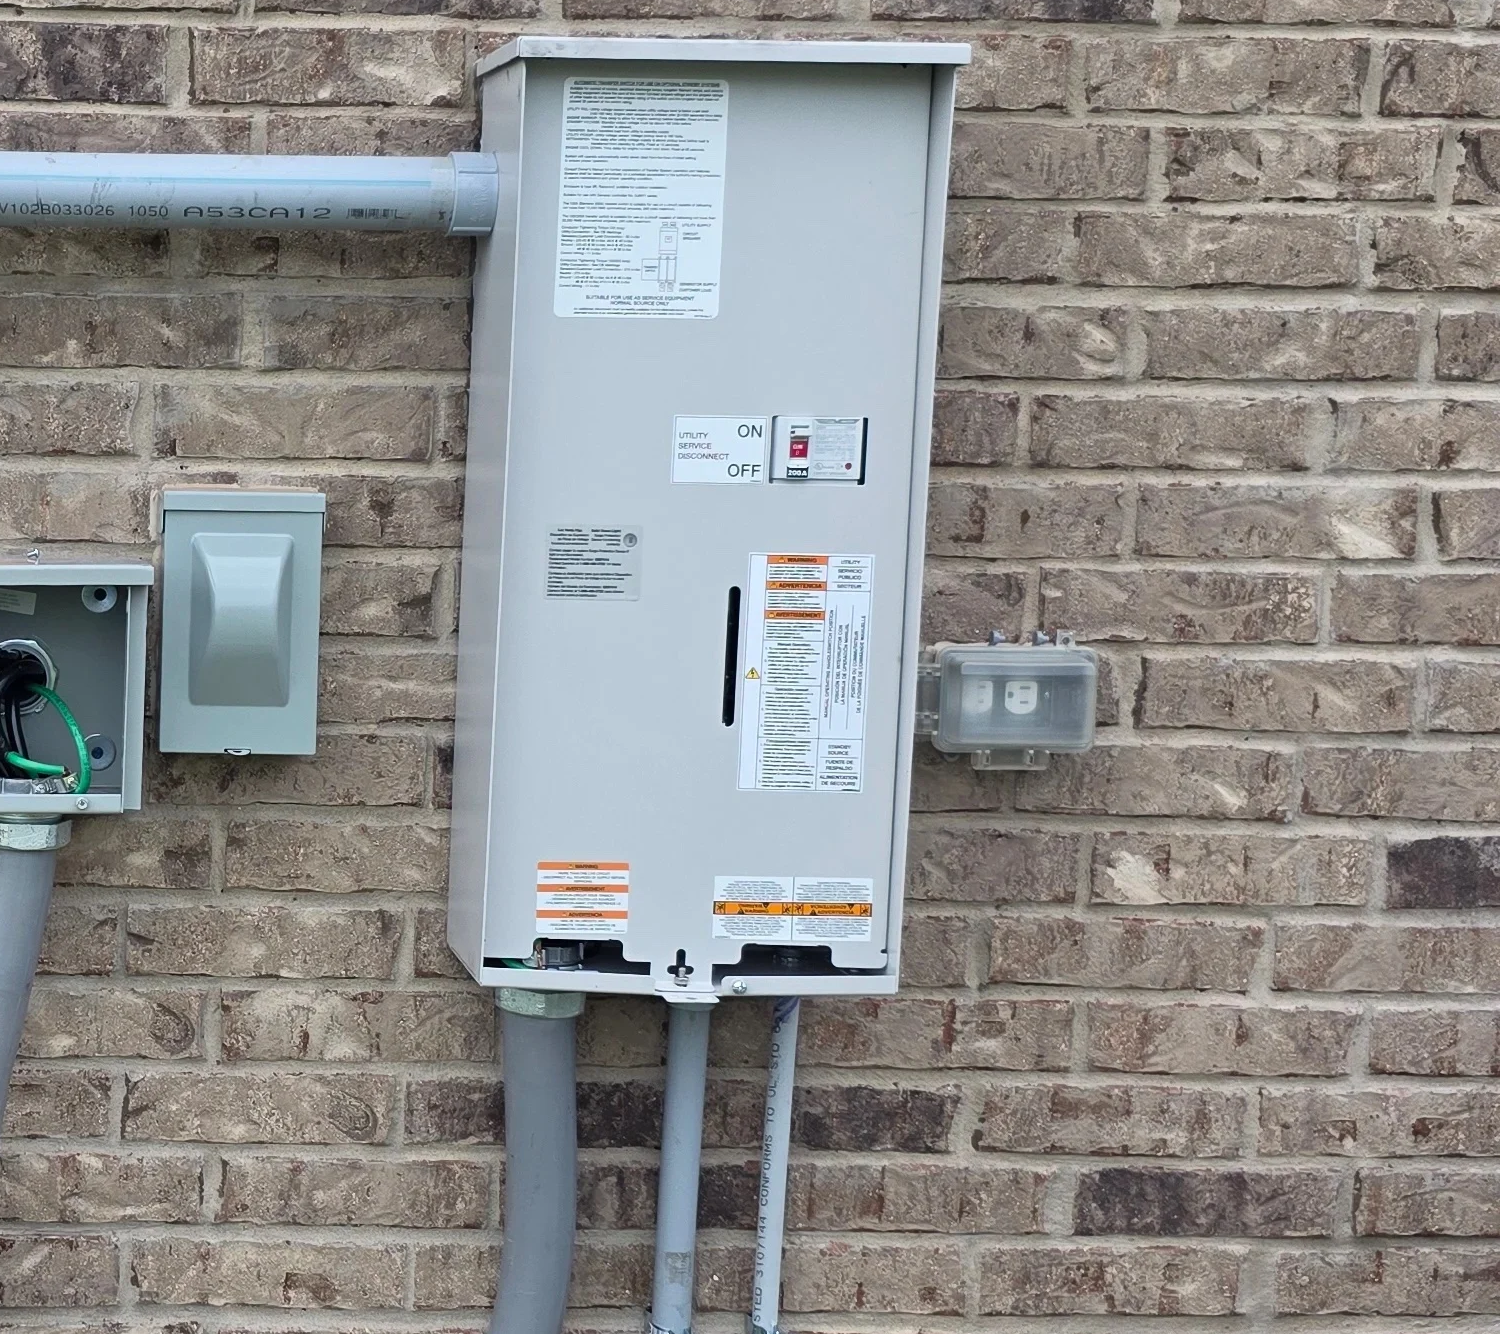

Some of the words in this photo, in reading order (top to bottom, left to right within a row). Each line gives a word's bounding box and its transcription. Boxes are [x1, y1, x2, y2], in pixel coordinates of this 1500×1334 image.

[129, 205, 169, 218] 1050
[183, 206, 332, 220] A53CA12
[738, 424, 763, 438] ON
[727, 464, 761, 477] OFF
[770, 1043, 780, 1070] STD
[767, 1081, 777, 1097] UL
[766, 1107, 775, 1123] TO
[760, 1134, 772, 1207] CONFORMS
[753, 1287, 762, 1323] STED
